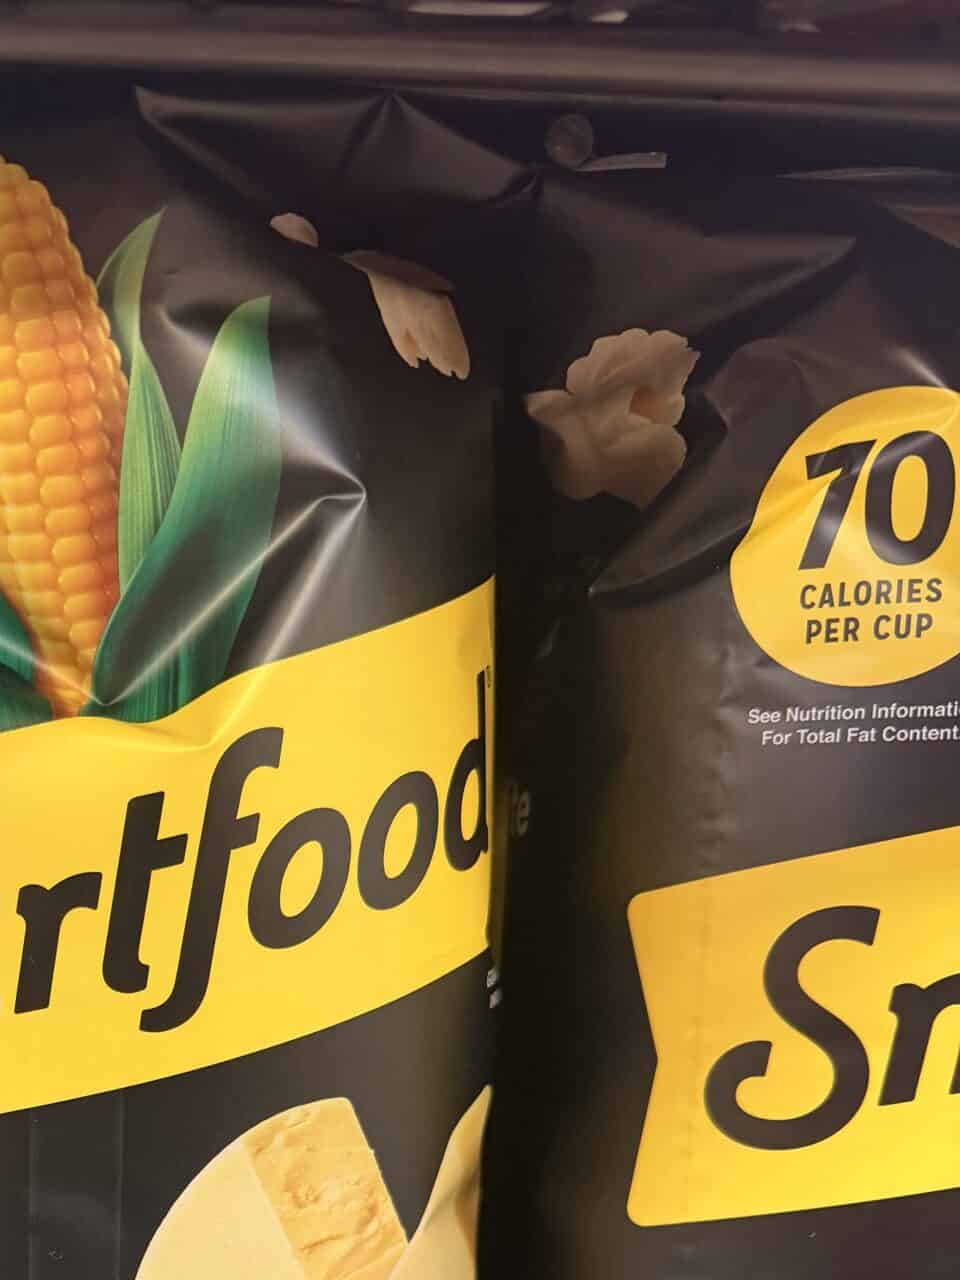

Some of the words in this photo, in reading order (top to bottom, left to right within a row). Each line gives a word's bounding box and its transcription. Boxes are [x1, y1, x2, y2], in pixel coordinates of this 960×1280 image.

[798, 430, 955, 571] 70
[800, 578, 943, 610] CALORIES
[805, 617, 860, 645] PER
[873, 613, 933, 641] CUP
[748, 708, 781, 724] See
[785, 705, 866, 723] Nutrition
[761, 730, 792, 746] For
[797, 728, 841, 745] Total
[847, 727, 878, 743] Fat
